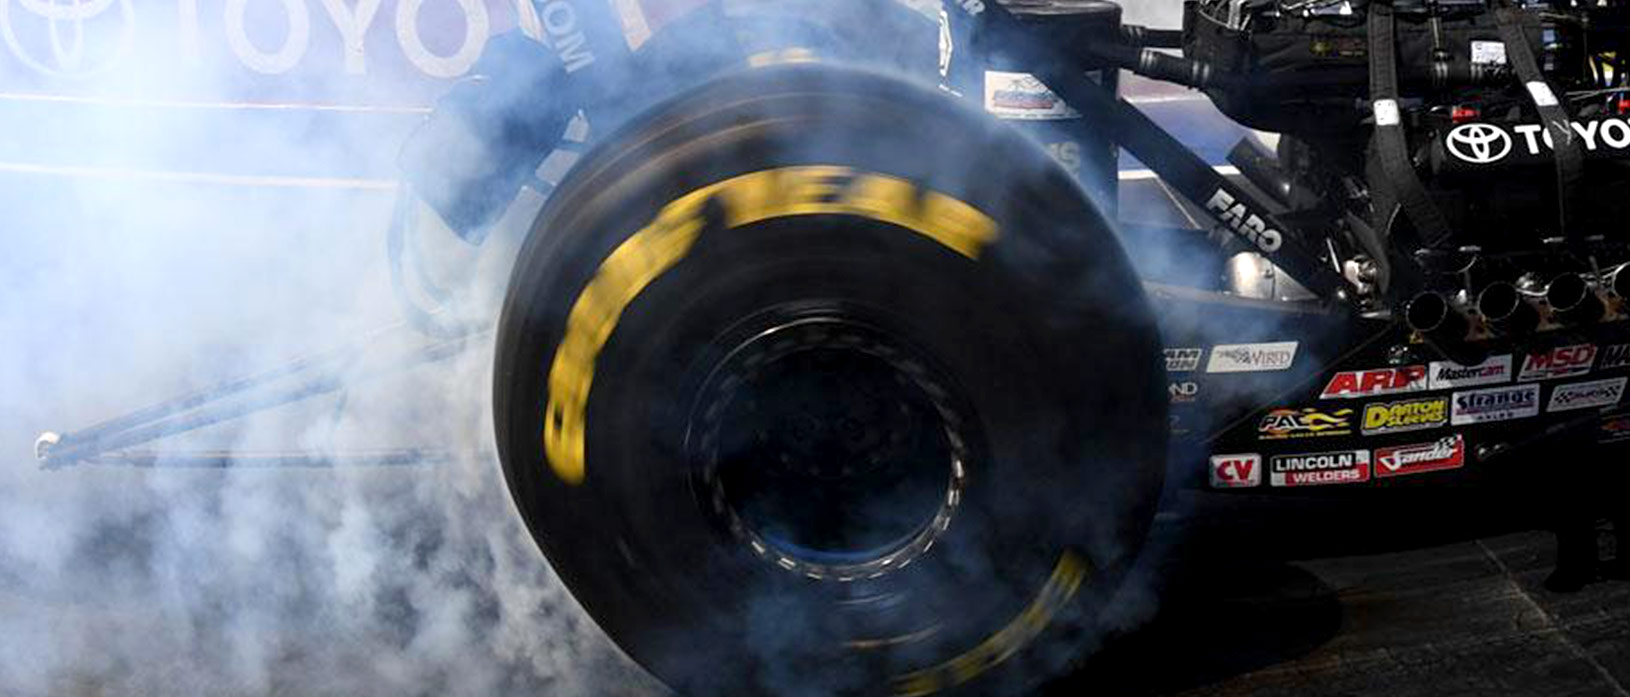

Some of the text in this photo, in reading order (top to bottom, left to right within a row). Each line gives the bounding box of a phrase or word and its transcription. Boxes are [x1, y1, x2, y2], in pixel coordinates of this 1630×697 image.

[1514, 118, 1630, 154] TYO
[1206, 188, 1283, 252] FARO
[1524, 345, 1599, 371] MSD
[1324, 366, 1427, 395] ARP
[1437, 365, 1505, 381] Mastercam
[1456, 390, 1536, 409] Strange
[1216, 458, 1254, 481] CV
[1276, 455, 1353, 472] LINCOLN
[1291, 468, 1361, 483] WELDERS
